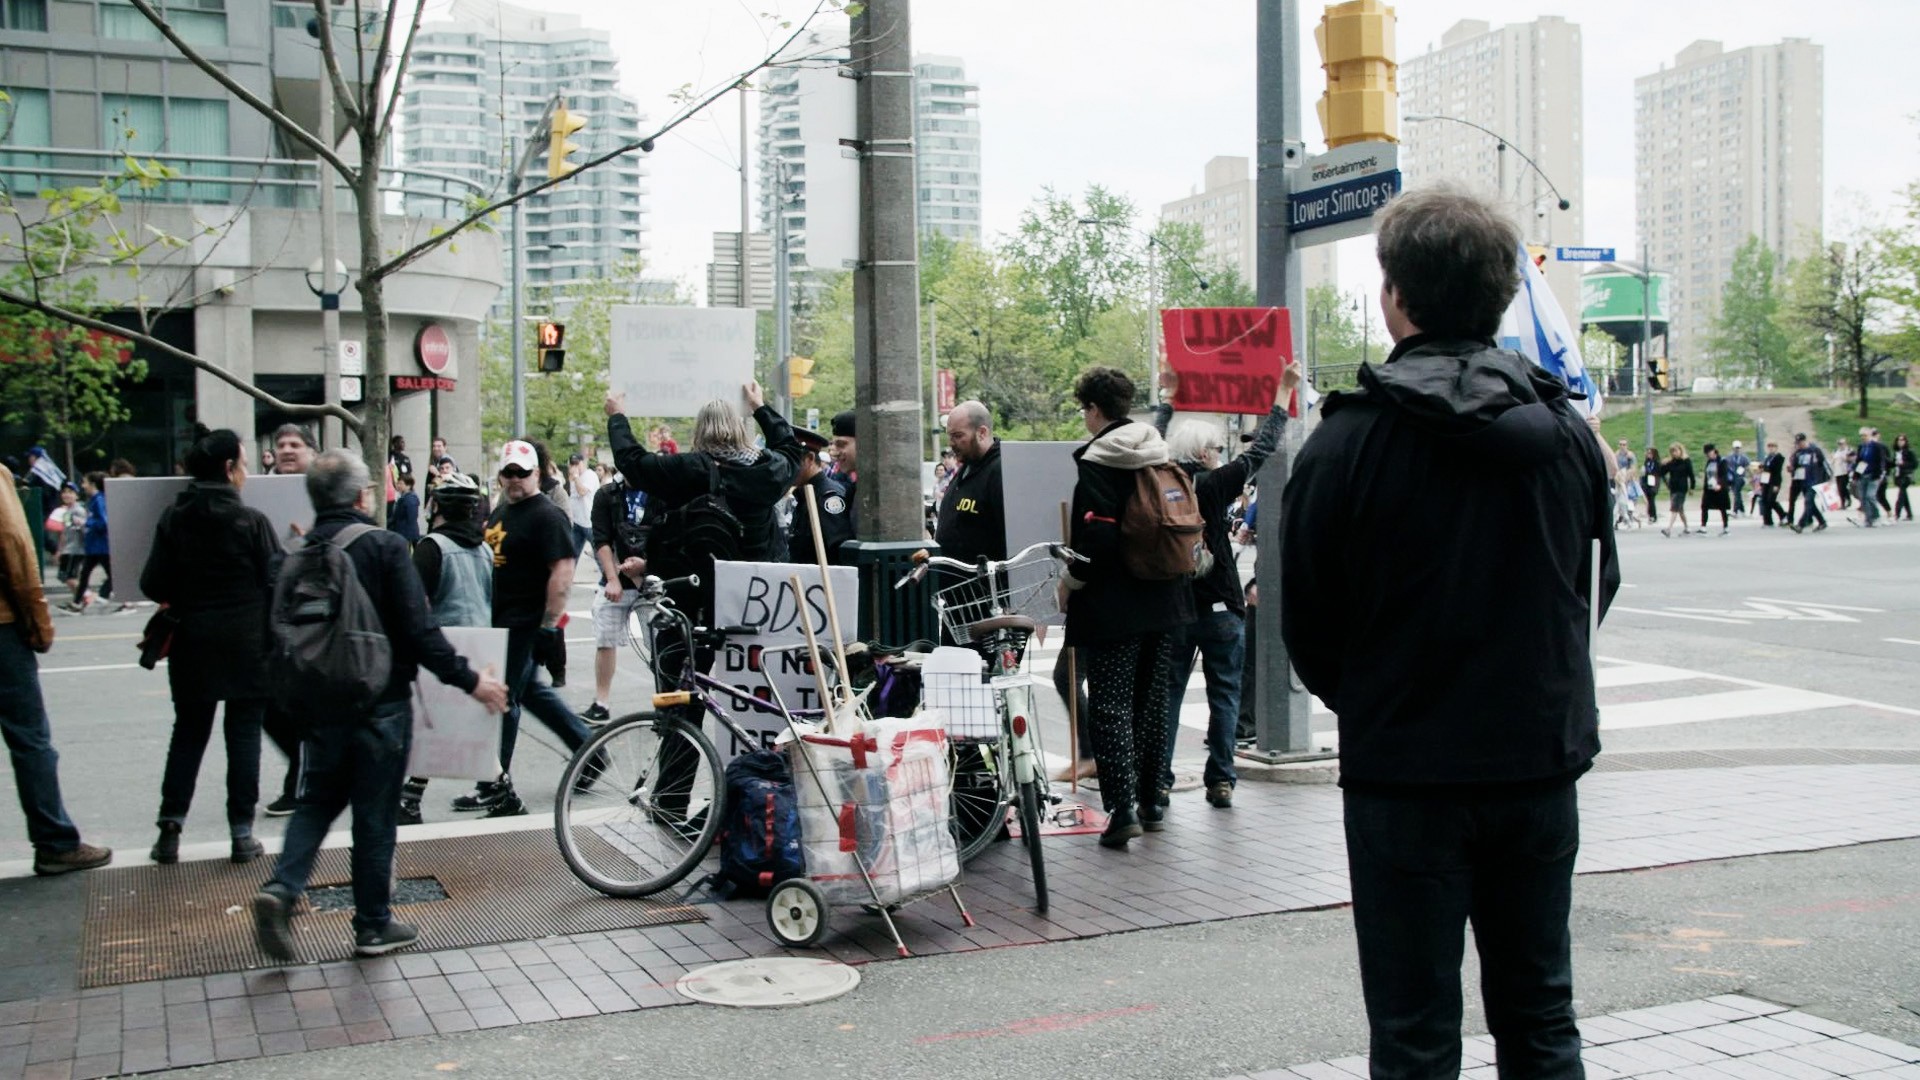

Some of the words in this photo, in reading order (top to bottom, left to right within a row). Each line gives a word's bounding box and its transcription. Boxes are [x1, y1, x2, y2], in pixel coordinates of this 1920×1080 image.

[1312, 156, 1378, 181] entertainment
[1293, 198, 1329, 225] Lower
[1331, 185, 1379, 215] Simcoe
[1381, 182, 1392, 203] St
[396, 376, 434, 389] SALES
[956, 497, 979, 514] JDL
[741, 576, 828, 635] BDS
[726, 644, 765, 672] DO
[731, 684, 772, 713] GO
[796, 686, 823, 710] T
